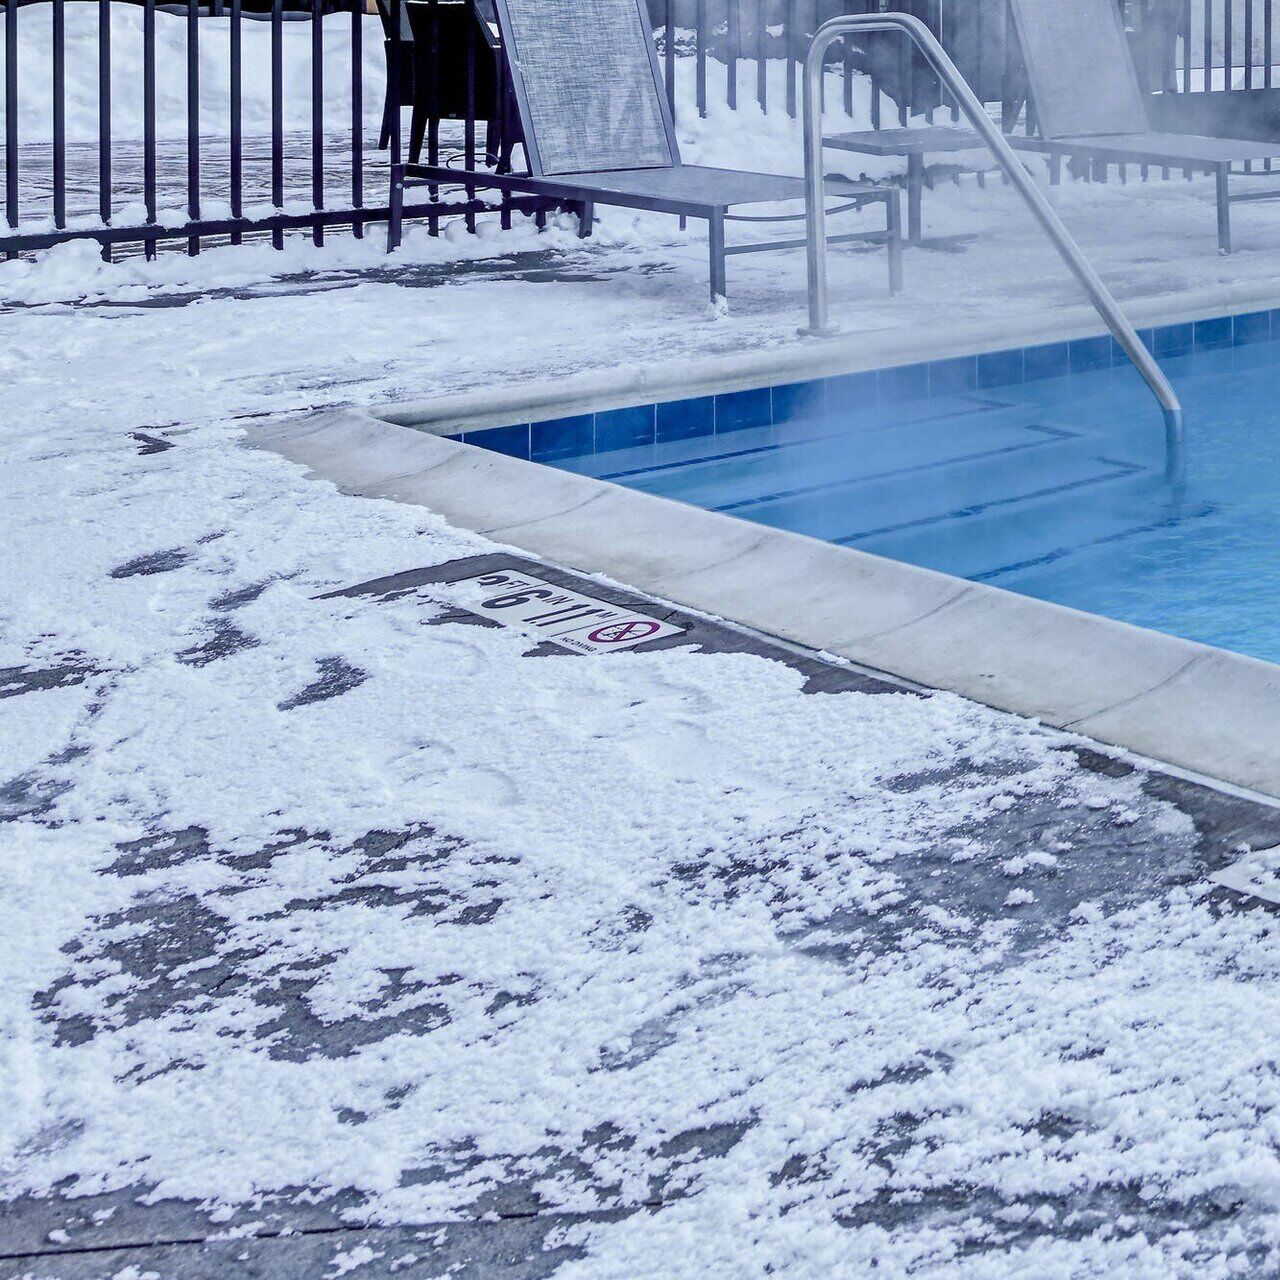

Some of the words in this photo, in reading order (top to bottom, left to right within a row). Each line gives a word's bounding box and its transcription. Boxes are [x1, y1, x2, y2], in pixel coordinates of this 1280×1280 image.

[498, 580, 531, 590] FT
[481, 589, 553, 609] 6
[542, 595, 575, 606] IN
[594, 611, 618, 620] M
